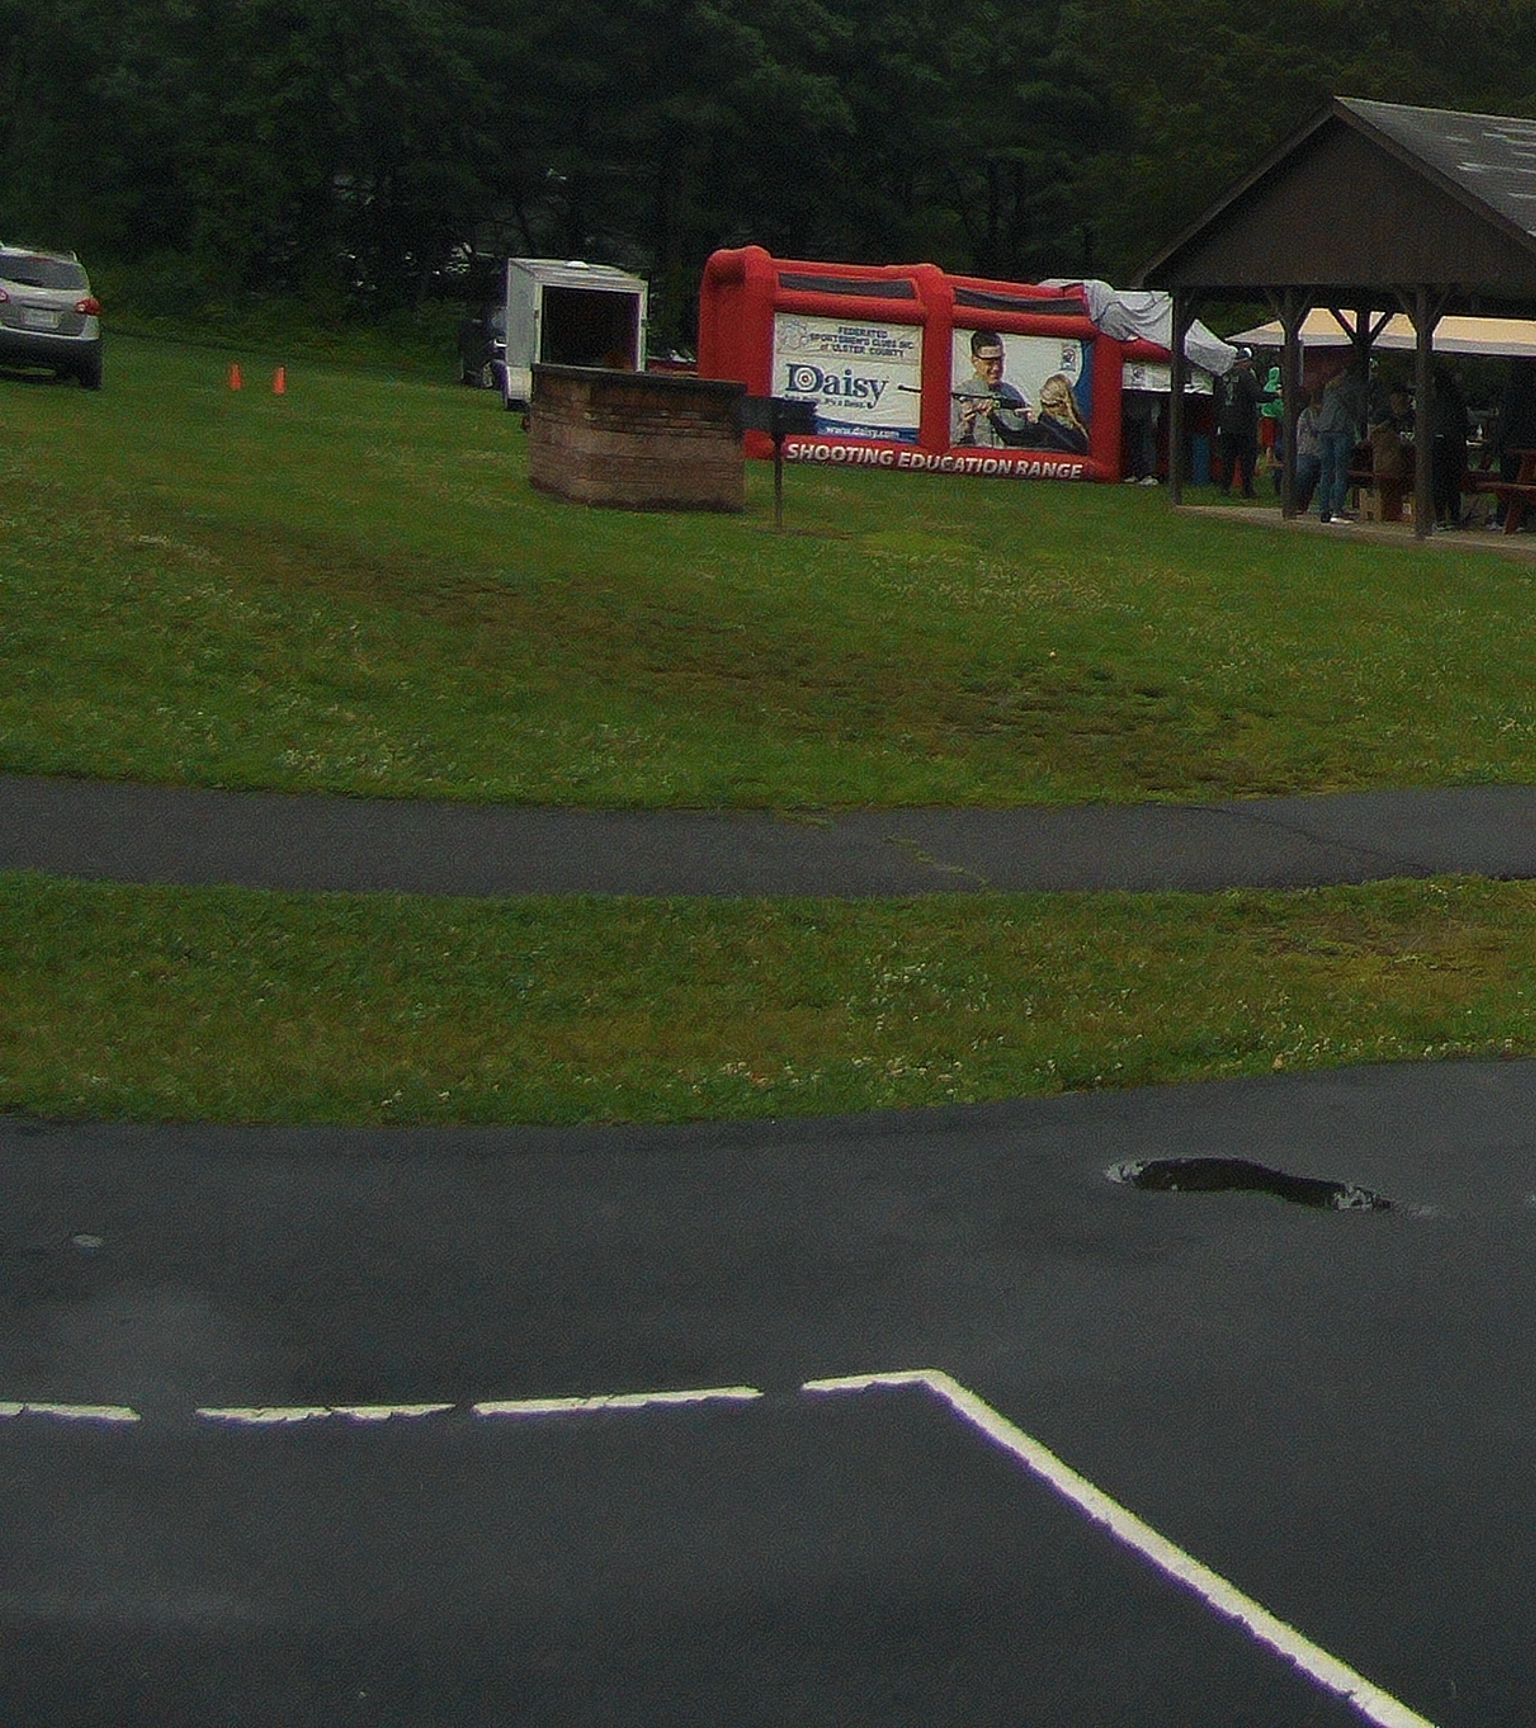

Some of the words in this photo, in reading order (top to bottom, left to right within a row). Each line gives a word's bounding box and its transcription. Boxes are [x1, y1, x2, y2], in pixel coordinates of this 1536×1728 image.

[785, 363, 889, 408] Daisy
[825, 426, 900, 439] www.daisy.com
[787, 443, 895, 466] SHOOTING
[898, 451, 1013, 474] EDUCATION
[1015, 459, 1083, 479] RANGE
